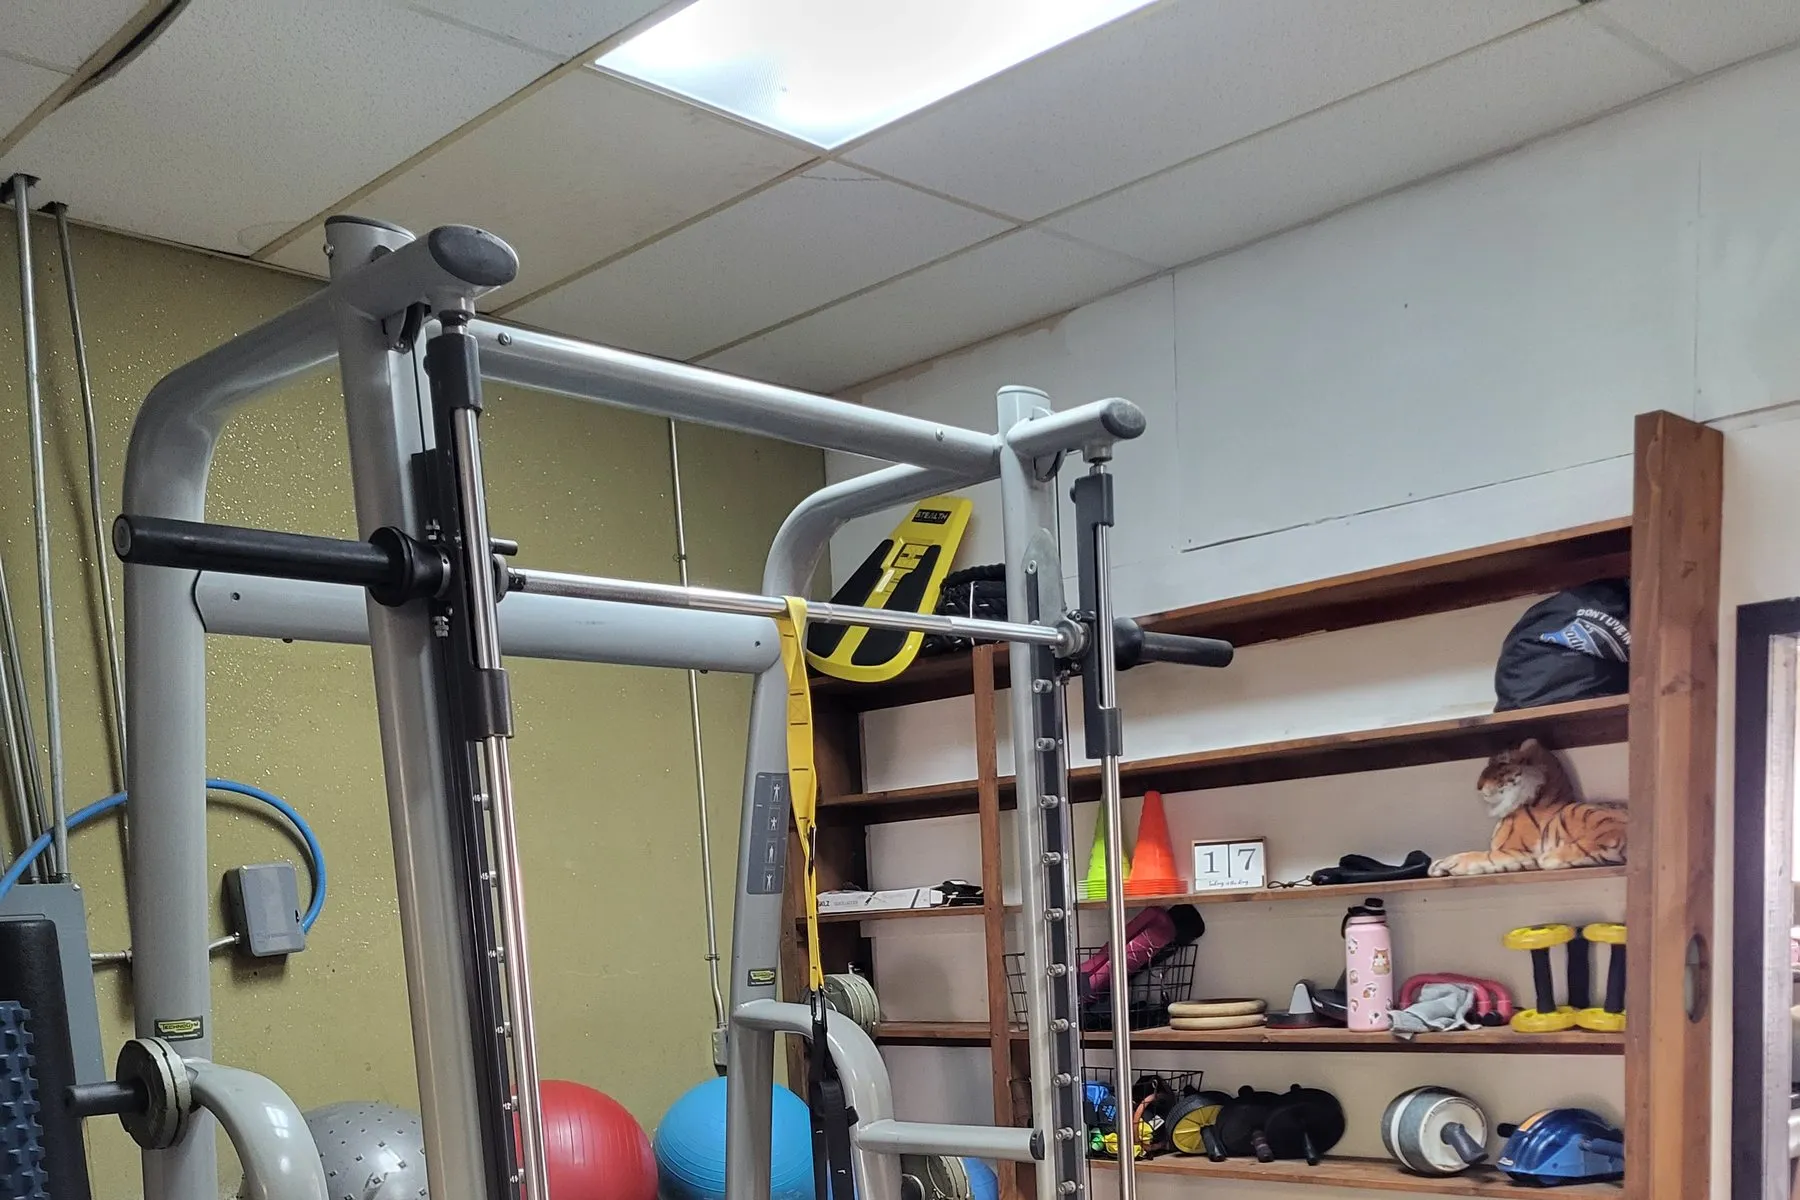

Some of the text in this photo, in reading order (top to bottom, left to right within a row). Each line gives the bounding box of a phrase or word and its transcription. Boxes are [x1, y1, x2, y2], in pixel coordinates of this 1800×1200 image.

[915, 511, 948, 520] STEALTH
[1204, 848, 1256, 874] 1 7
